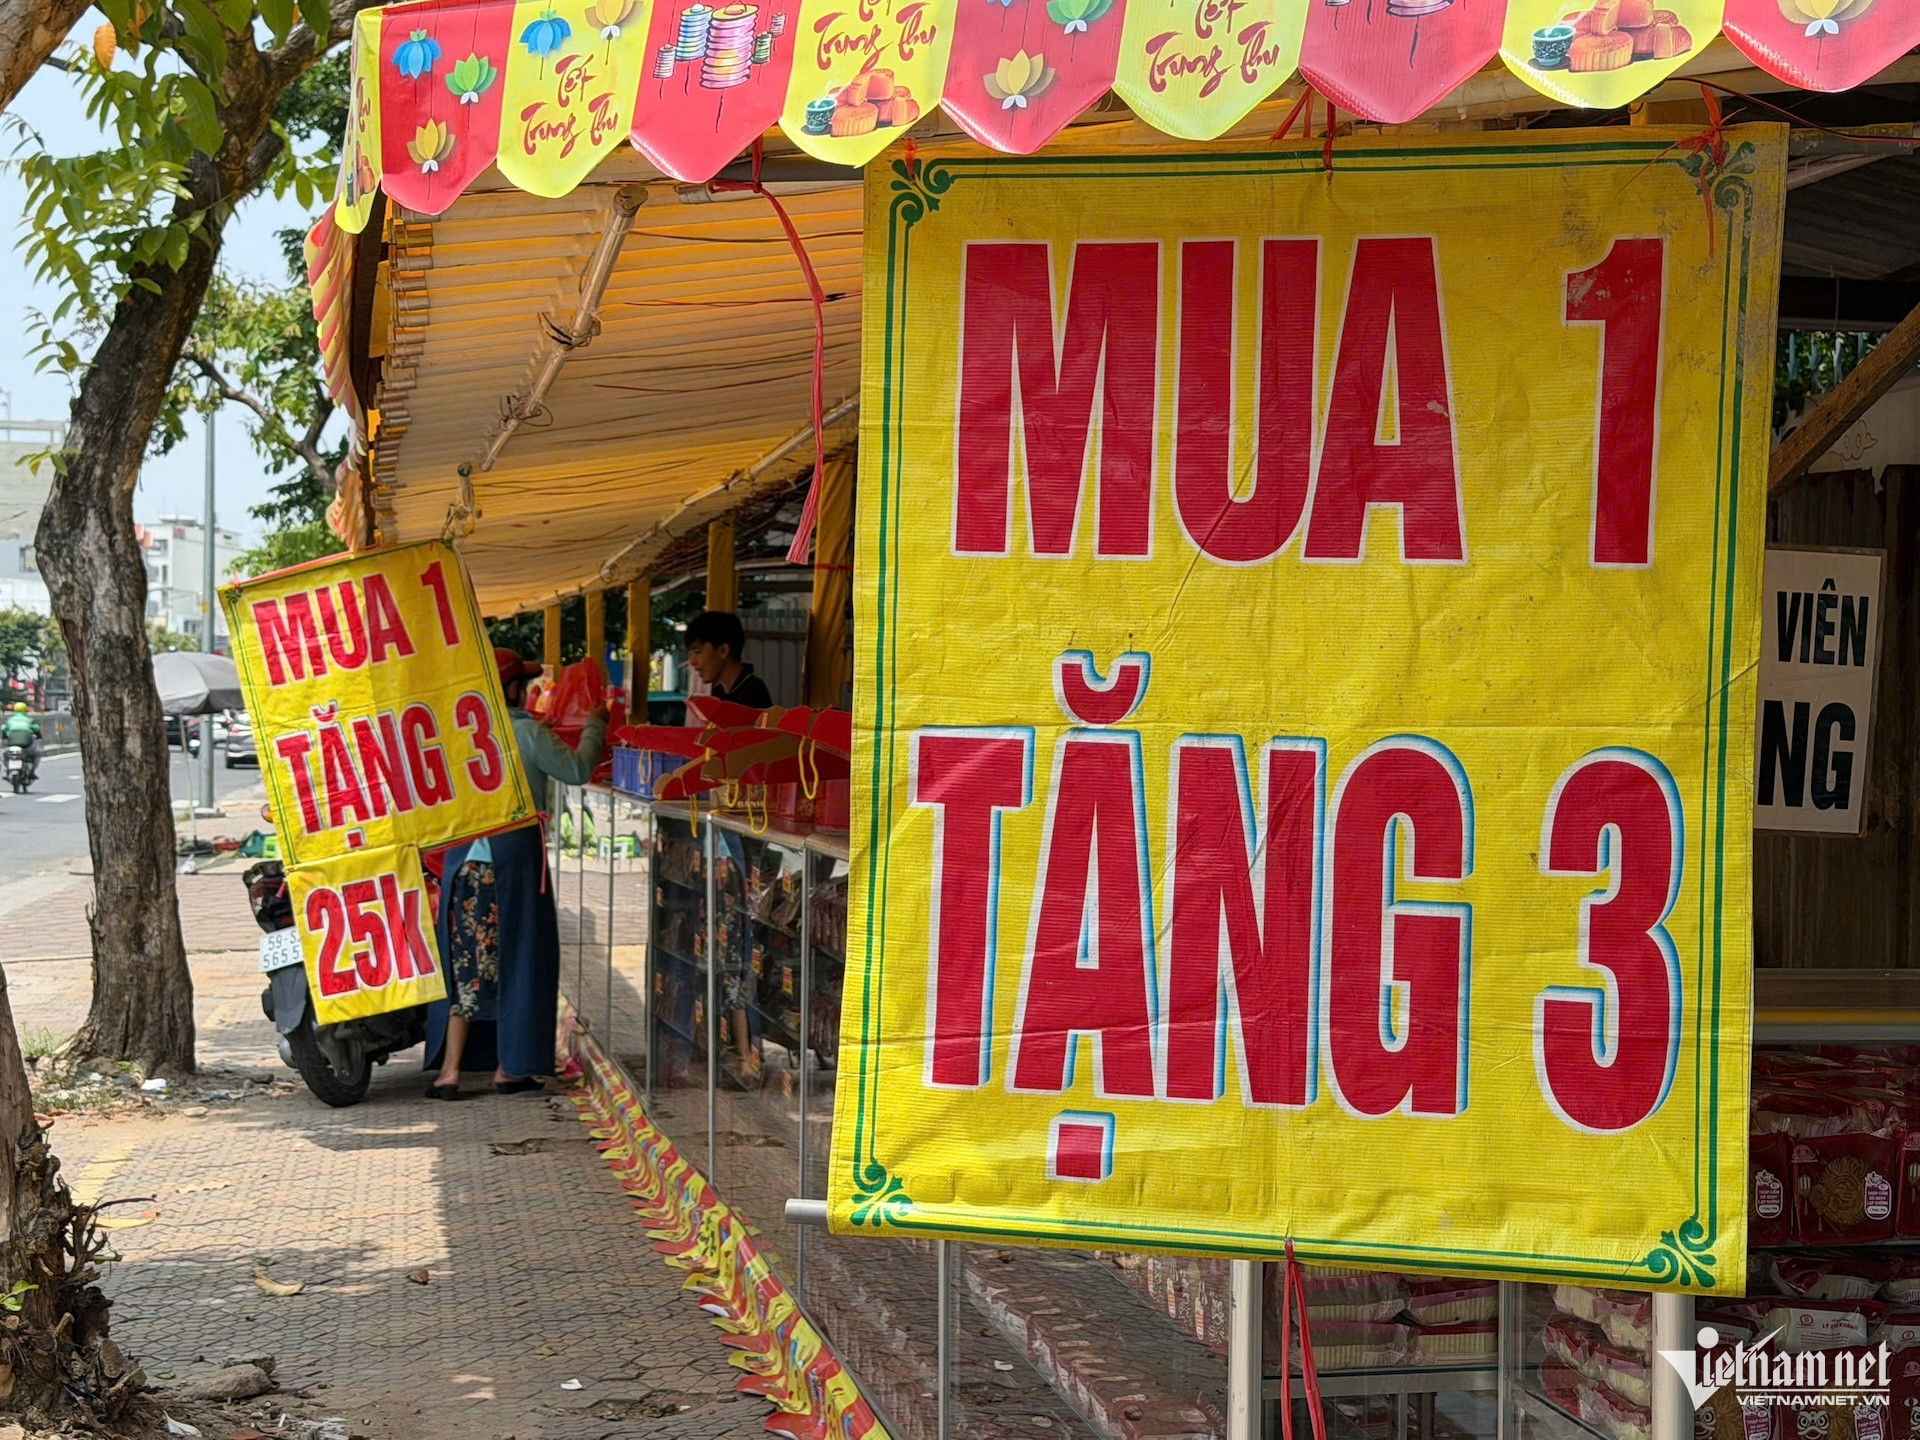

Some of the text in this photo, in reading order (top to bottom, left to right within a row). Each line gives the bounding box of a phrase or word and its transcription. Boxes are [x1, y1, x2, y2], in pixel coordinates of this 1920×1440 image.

[813, 2, 937, 75] Trung Thu
[1145, 21, 1280, 98] Trung Thu
[555, 54, 597, 108] Tết
[520, 92, 618, 159] Trung Thu
[951, 234, 1668, 569] MUA 1
[252, 559, 461, 688] MUA 1
[1777, 578, 1869, 667] VIÊN
[275, 690, 505, 849] TẶNG 3
[268, 930, 300, 951] 59-S
[909, 650, 1684, 1182] TẶNG 3
[263, 945, 301, 969] 565.5
